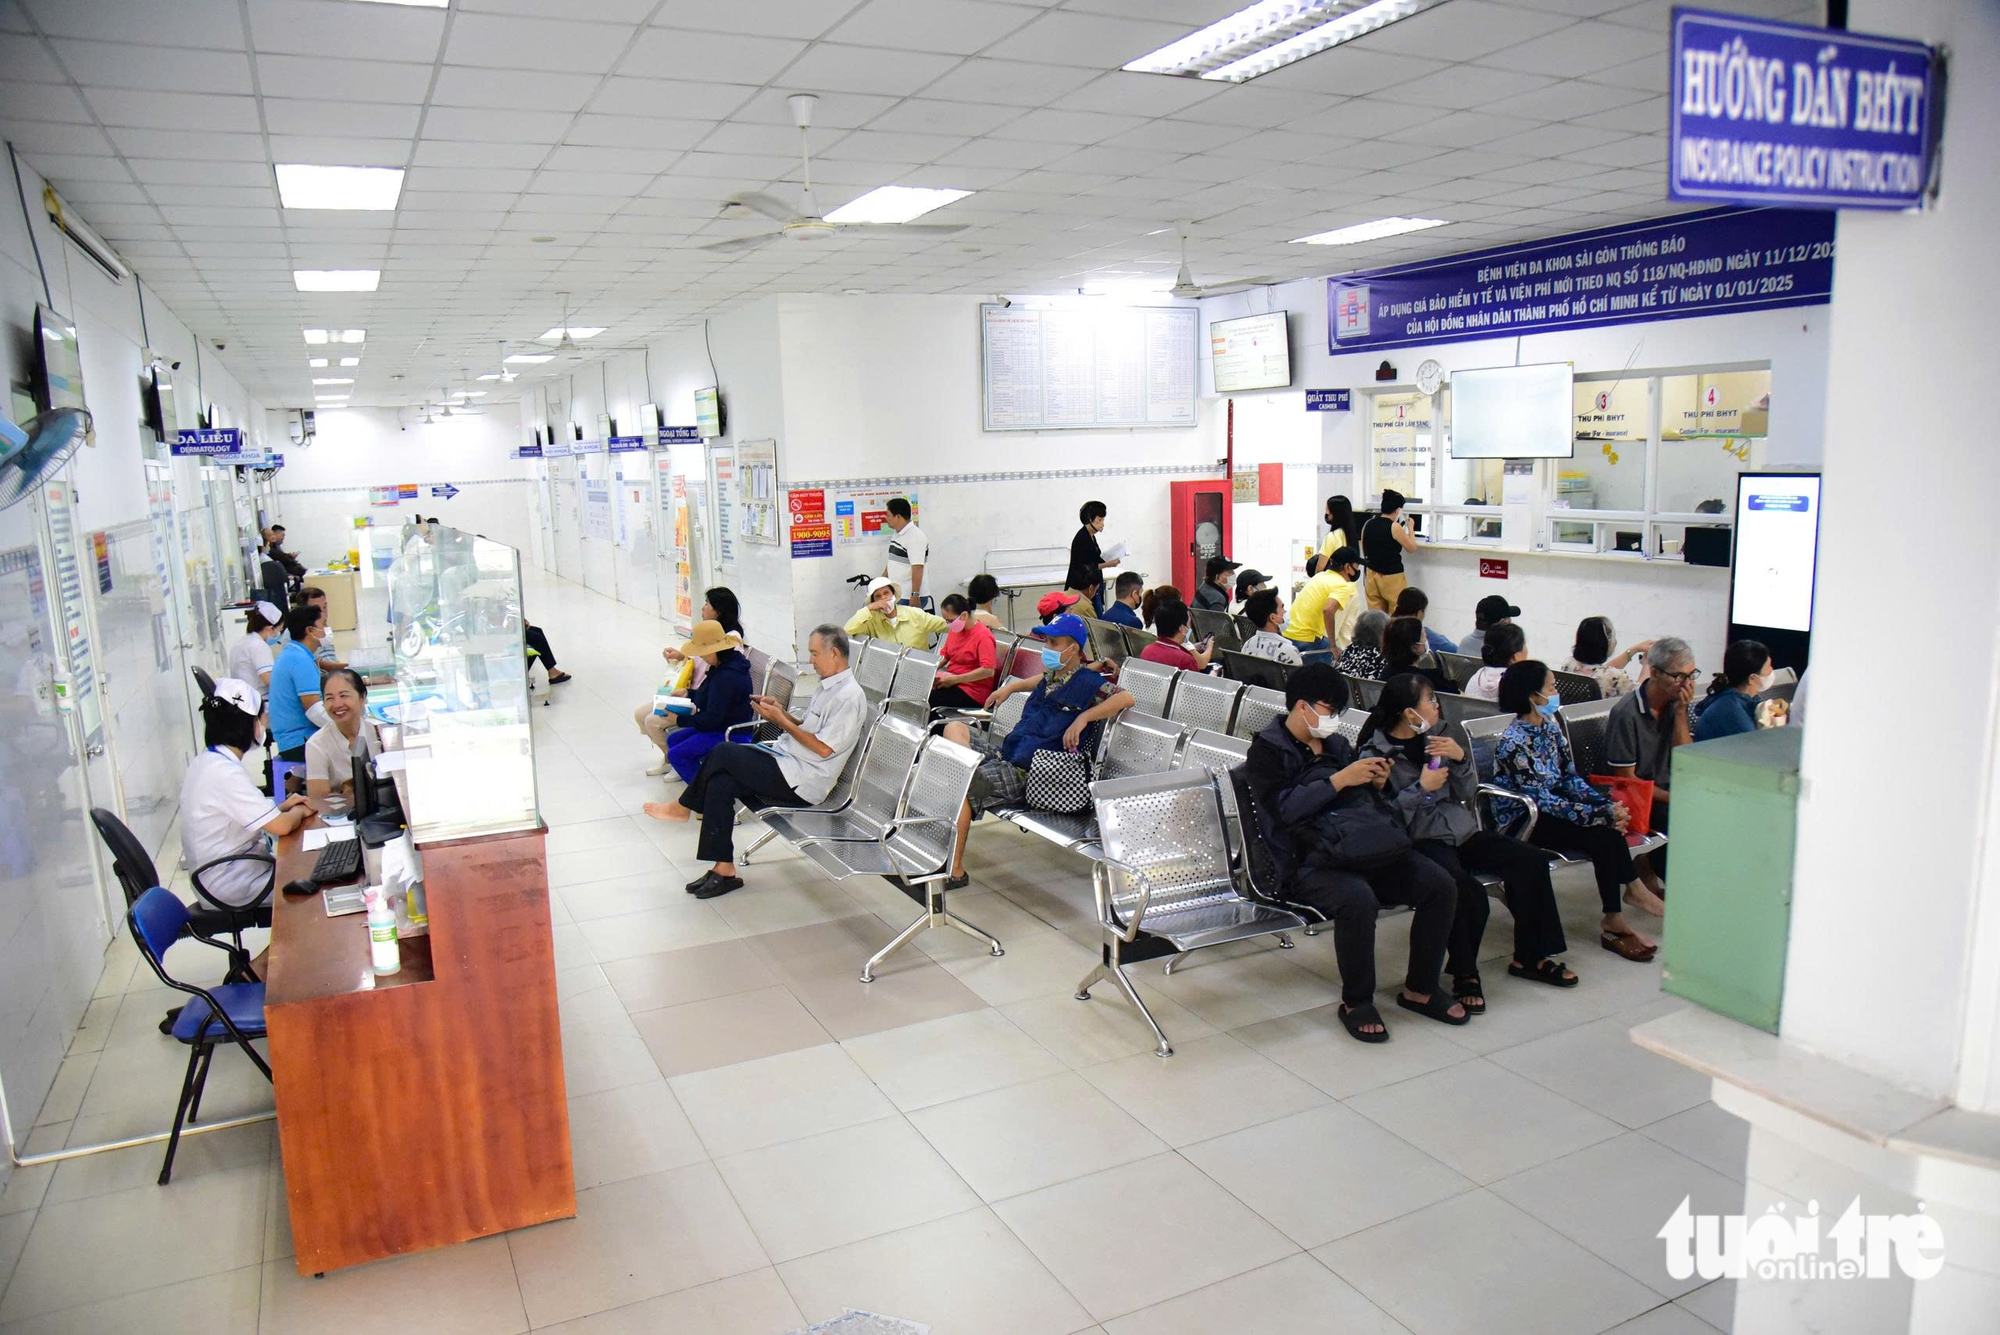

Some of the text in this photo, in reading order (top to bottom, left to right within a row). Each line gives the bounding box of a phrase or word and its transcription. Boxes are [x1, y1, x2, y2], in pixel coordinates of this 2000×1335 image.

[1682, 36, 1787, 124] HƯỚNG
[1681, 137, 1920, 192] INSURANCE POLICY INSTRUCTION
[1477, 234, 1686, 284] BỆNH VIỆN ĐA KHOA SÀI GÒN THÔNG BÁO
[1378, 240, 1837, 318] ÁP DỤNG GIÁ BẢO HIỂM Y TẾ VÀ VIỆN PHÍ MỚI THEO NQ SỐ 118/NQ-HĐND NGÀY 11/12/202
[1407, 274, 1794, 335] CỦA HỘI ĐỒNG NHÂN DÂN THÀNH PHỐ HỒ CHÍ MINH KỂ TỪ NGÀY 01/01/2025
[1324, 393, 1337, 402] THU
[1601, 393, 1607, 410] 3
[1708, 388, 1714, 405] 4
[1398, 405, 1404, 418] 1
[1716, 409, 1738, 417] BHYT
[180, 445, 231, 454] DERMATOLOGY
[793, 529, 831, 540] 1900-9095
